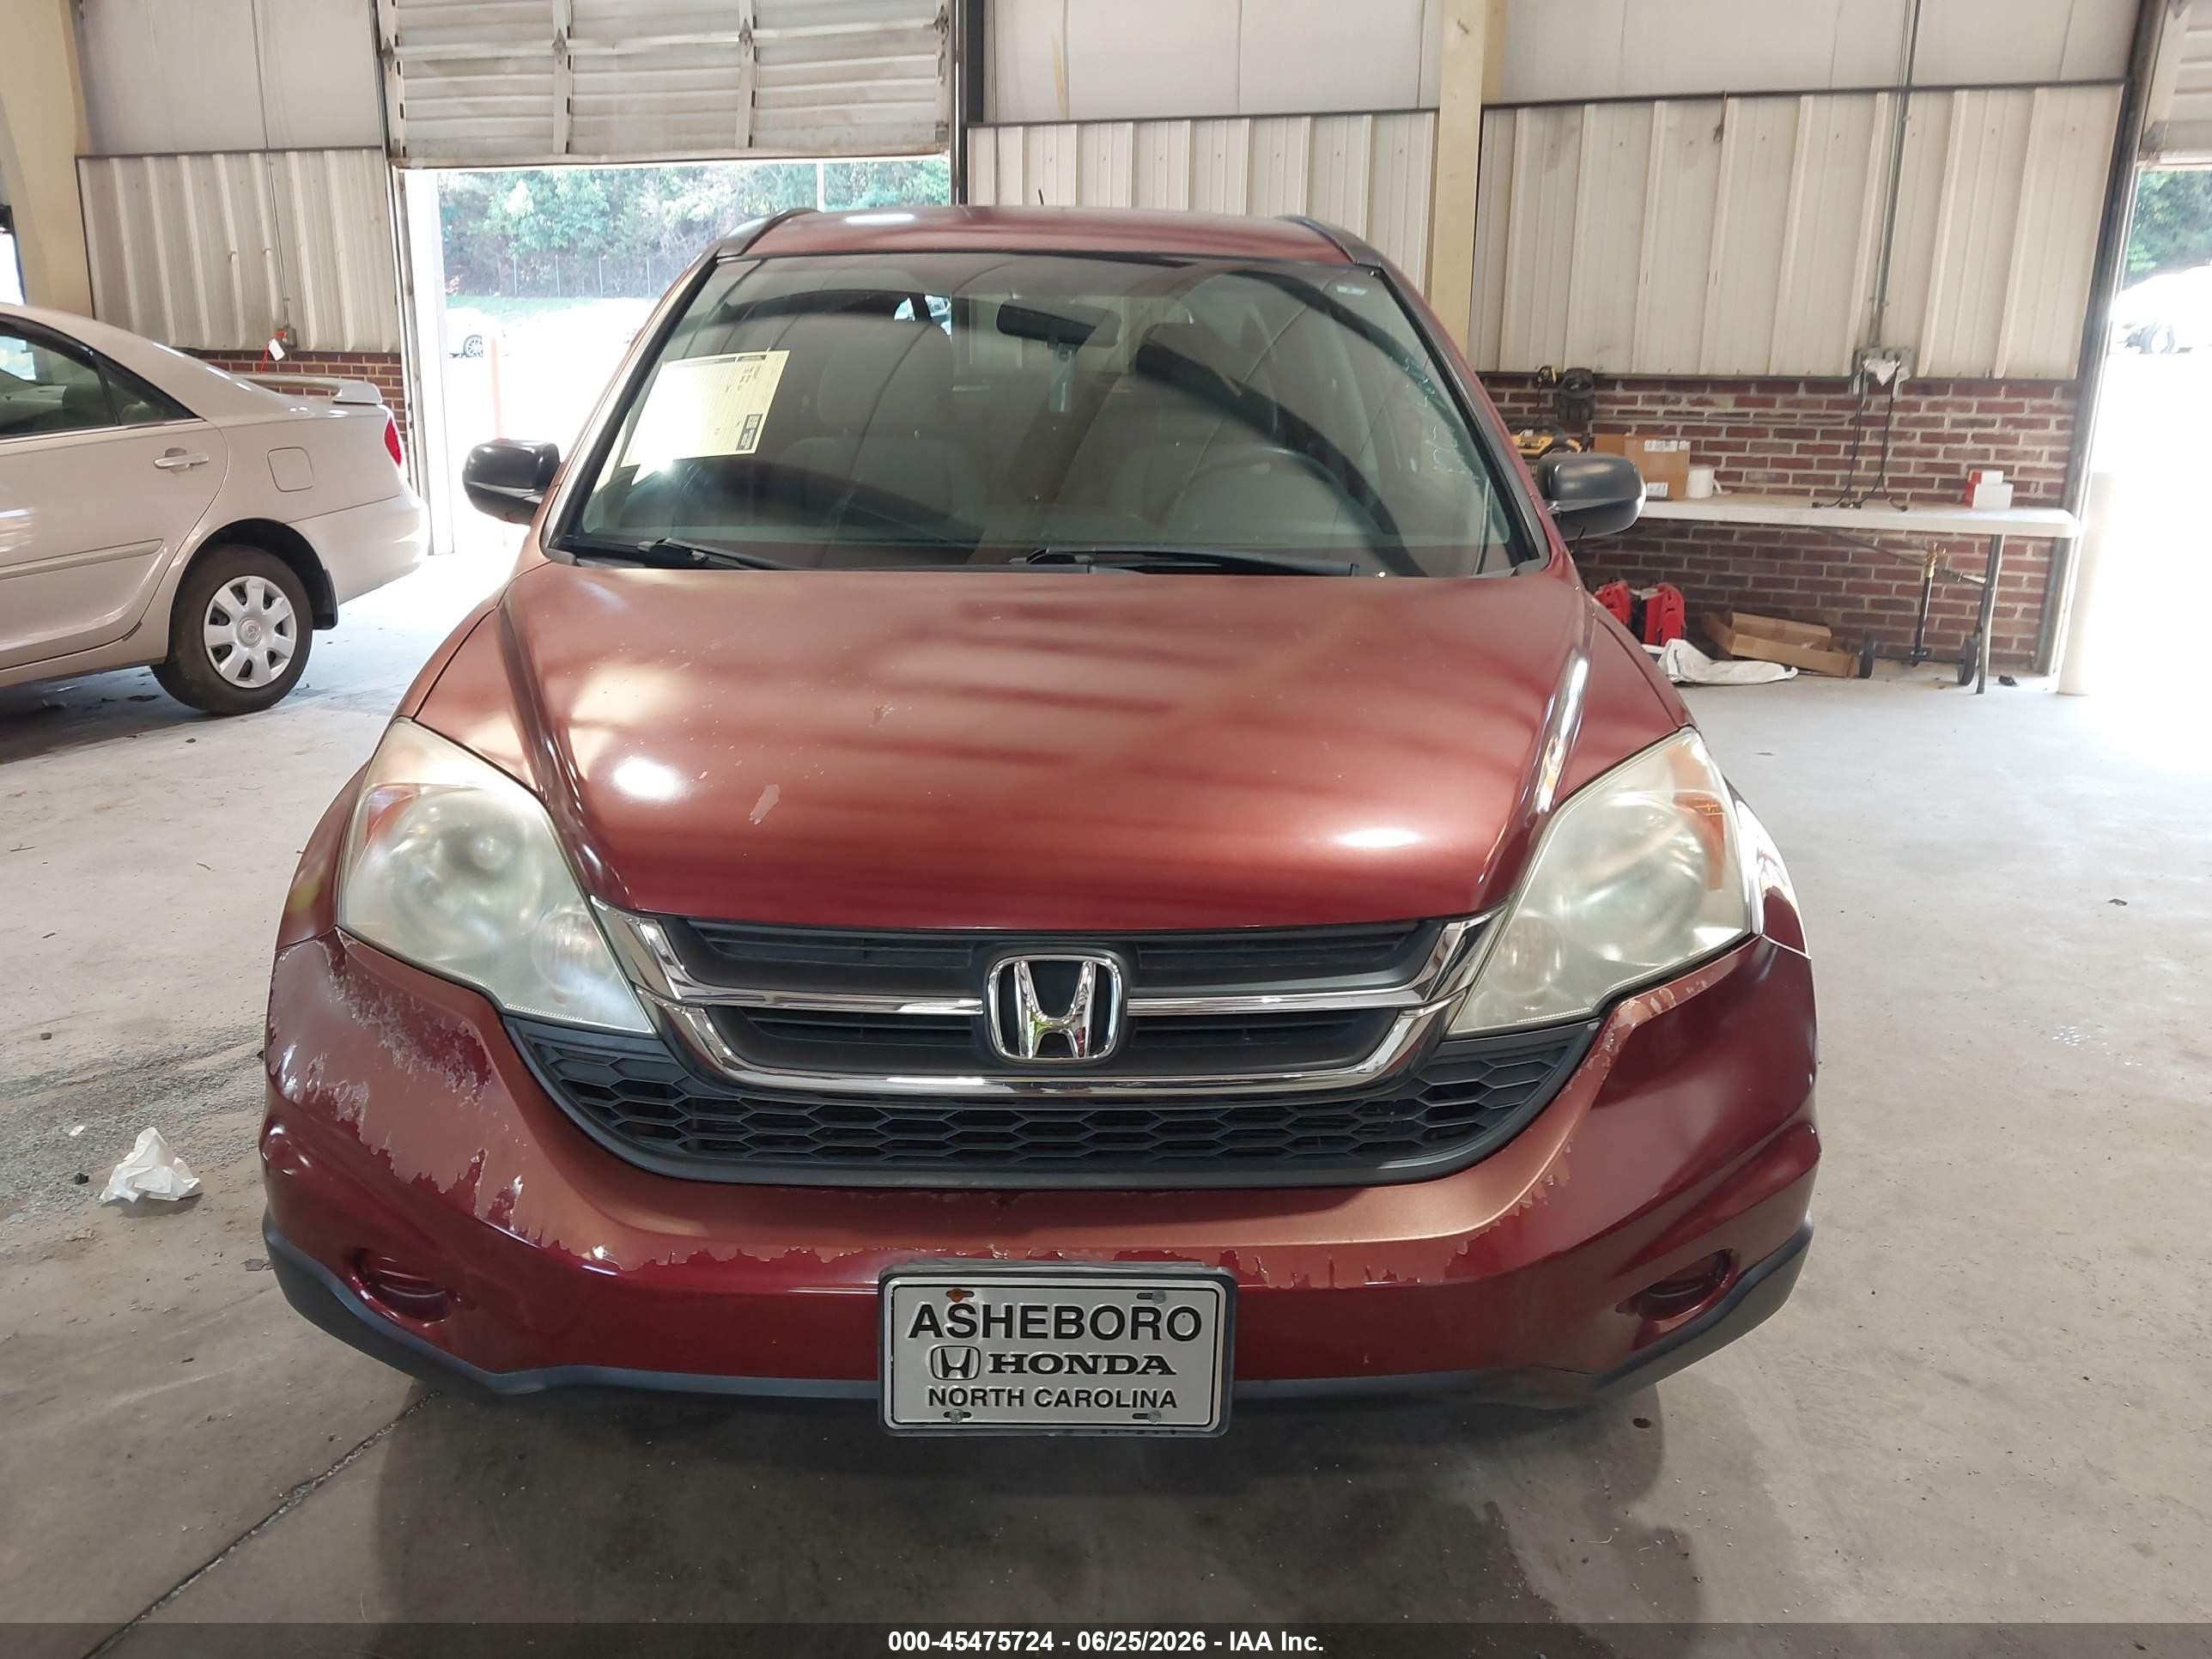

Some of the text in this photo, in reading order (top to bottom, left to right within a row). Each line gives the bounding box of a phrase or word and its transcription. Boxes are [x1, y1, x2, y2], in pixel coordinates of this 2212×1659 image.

[908, 1304, 1202, 1341] ASHEBORO
[988, 1353, 1177, 1376] HONDA
[928, 1388, 1178, 1408] NORTH CAROLINA
